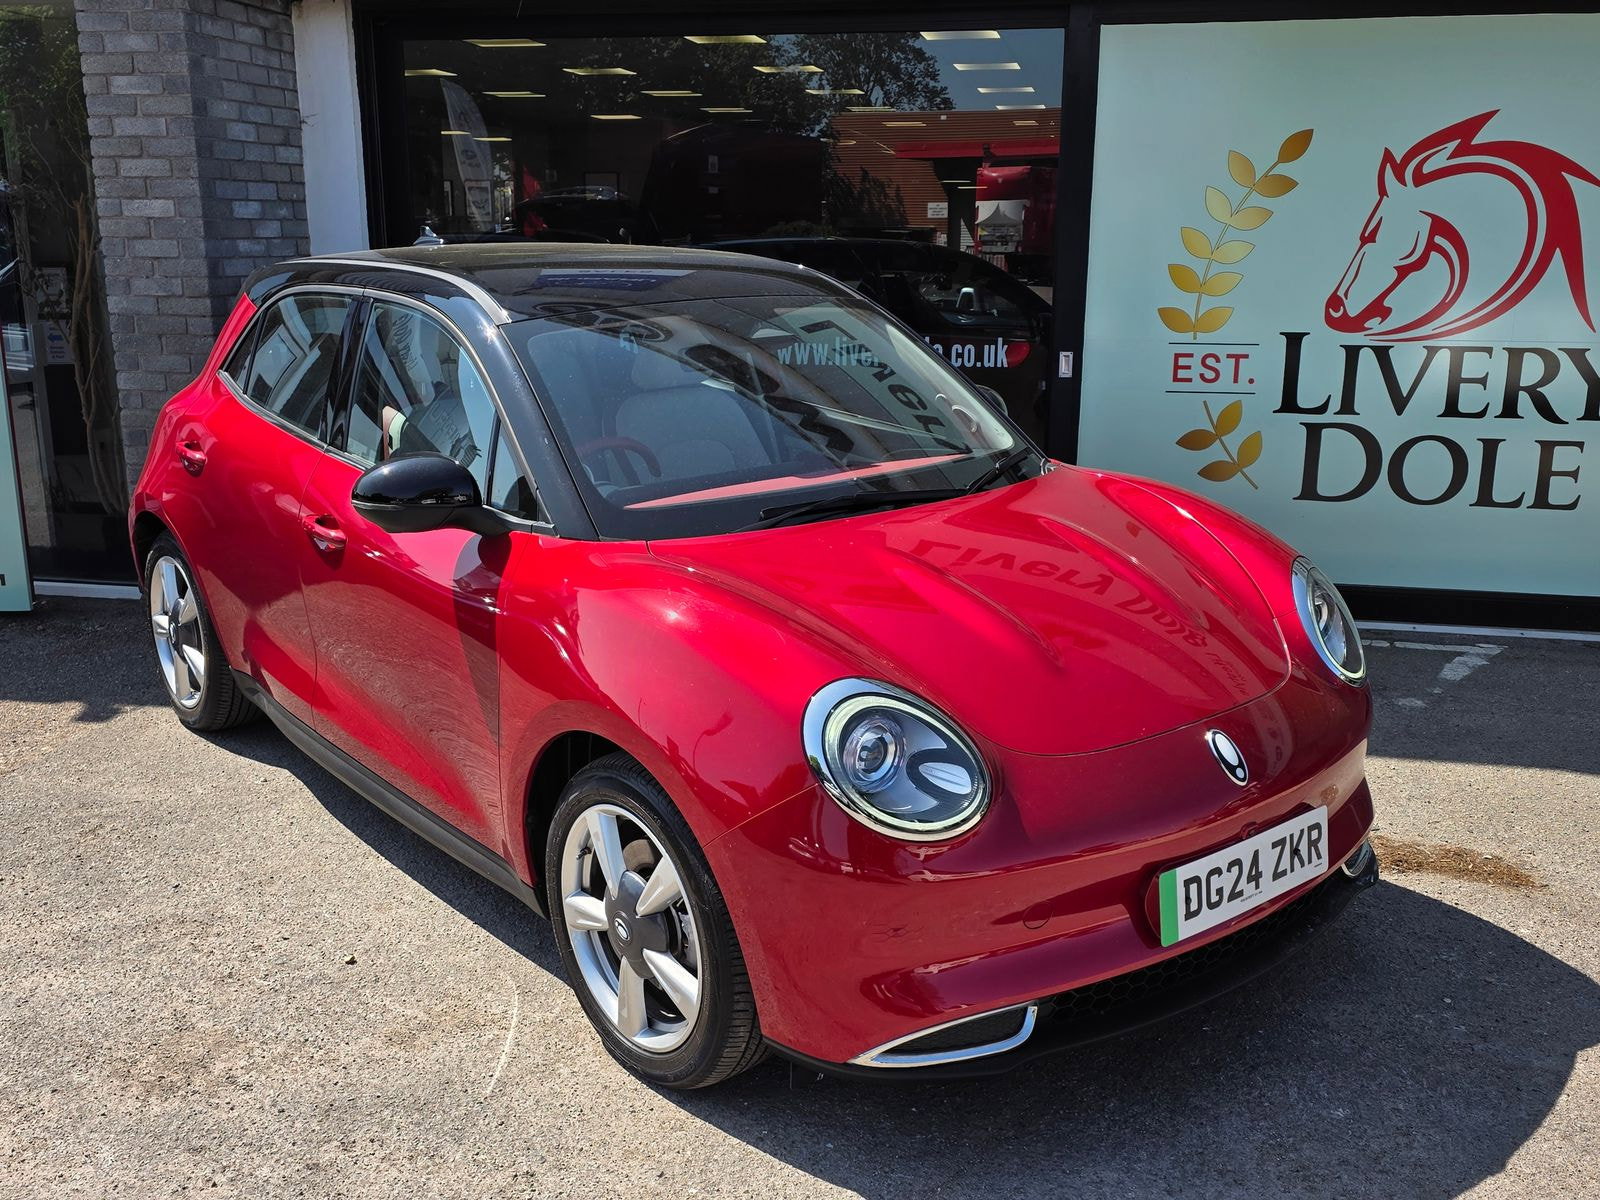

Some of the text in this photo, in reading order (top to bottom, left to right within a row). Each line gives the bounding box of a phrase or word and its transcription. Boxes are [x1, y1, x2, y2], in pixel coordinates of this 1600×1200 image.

[1171, 353, 1255, 385] EST.
[1273, 332, 1600, 424] LIVERY
[1293, 422, 1585, 511] DOLE
[1183, 821, 1323, 921] DG24 ZKR
